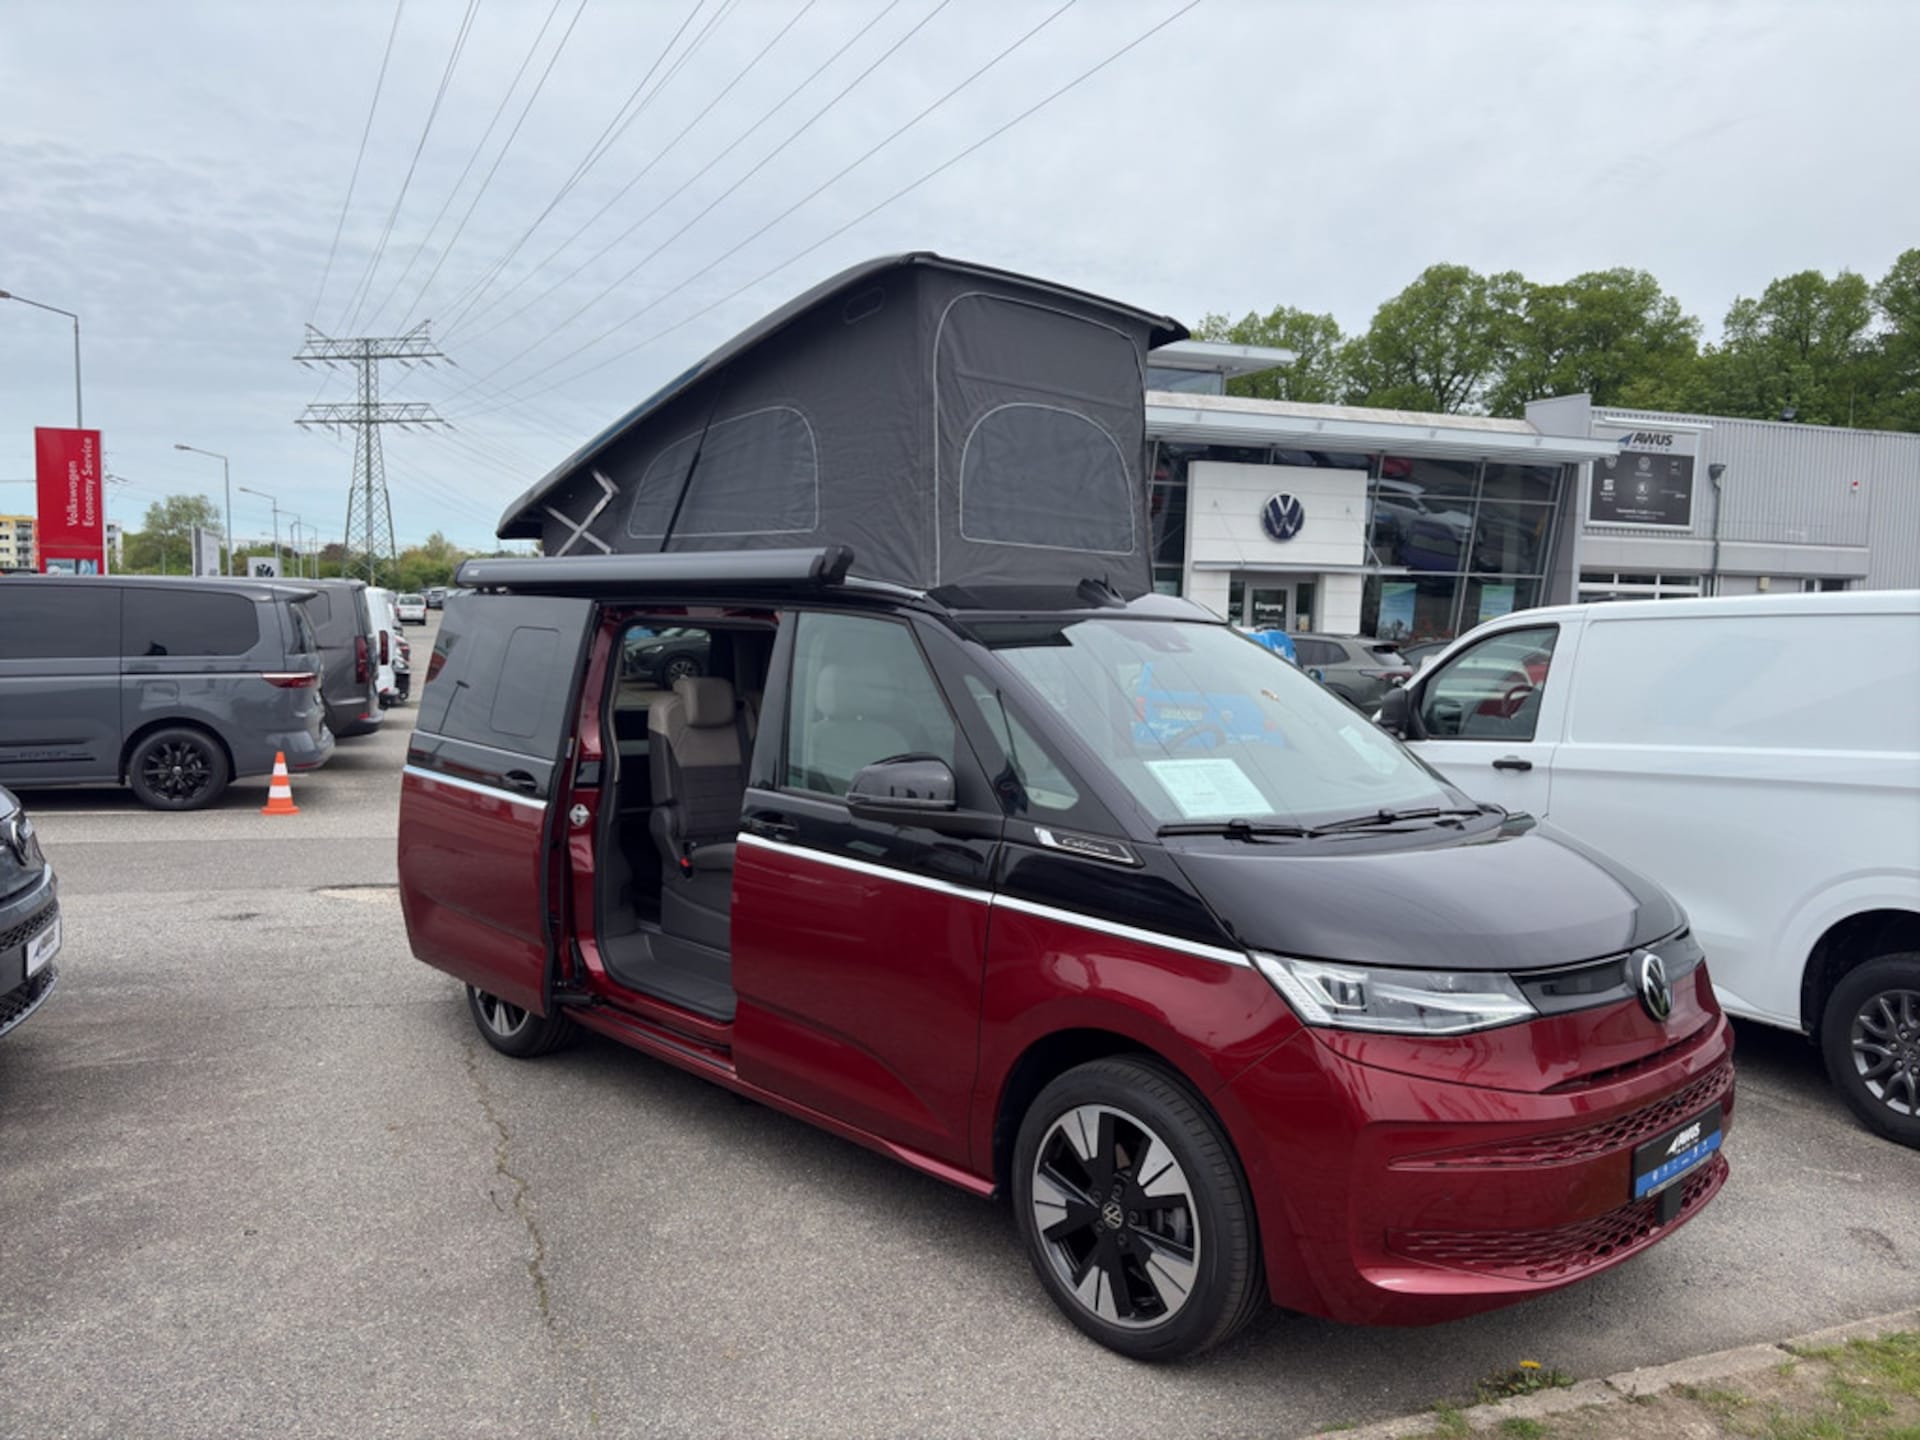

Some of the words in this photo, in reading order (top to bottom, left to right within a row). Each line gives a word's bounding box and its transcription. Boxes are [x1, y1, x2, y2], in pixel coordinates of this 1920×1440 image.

[81, 437, 93, 476] Service
[1632, 432, 1673, 446] AWUS
[66, 460, 80, 526] Volkswagen
[82, 478, 95, 527] Economy
